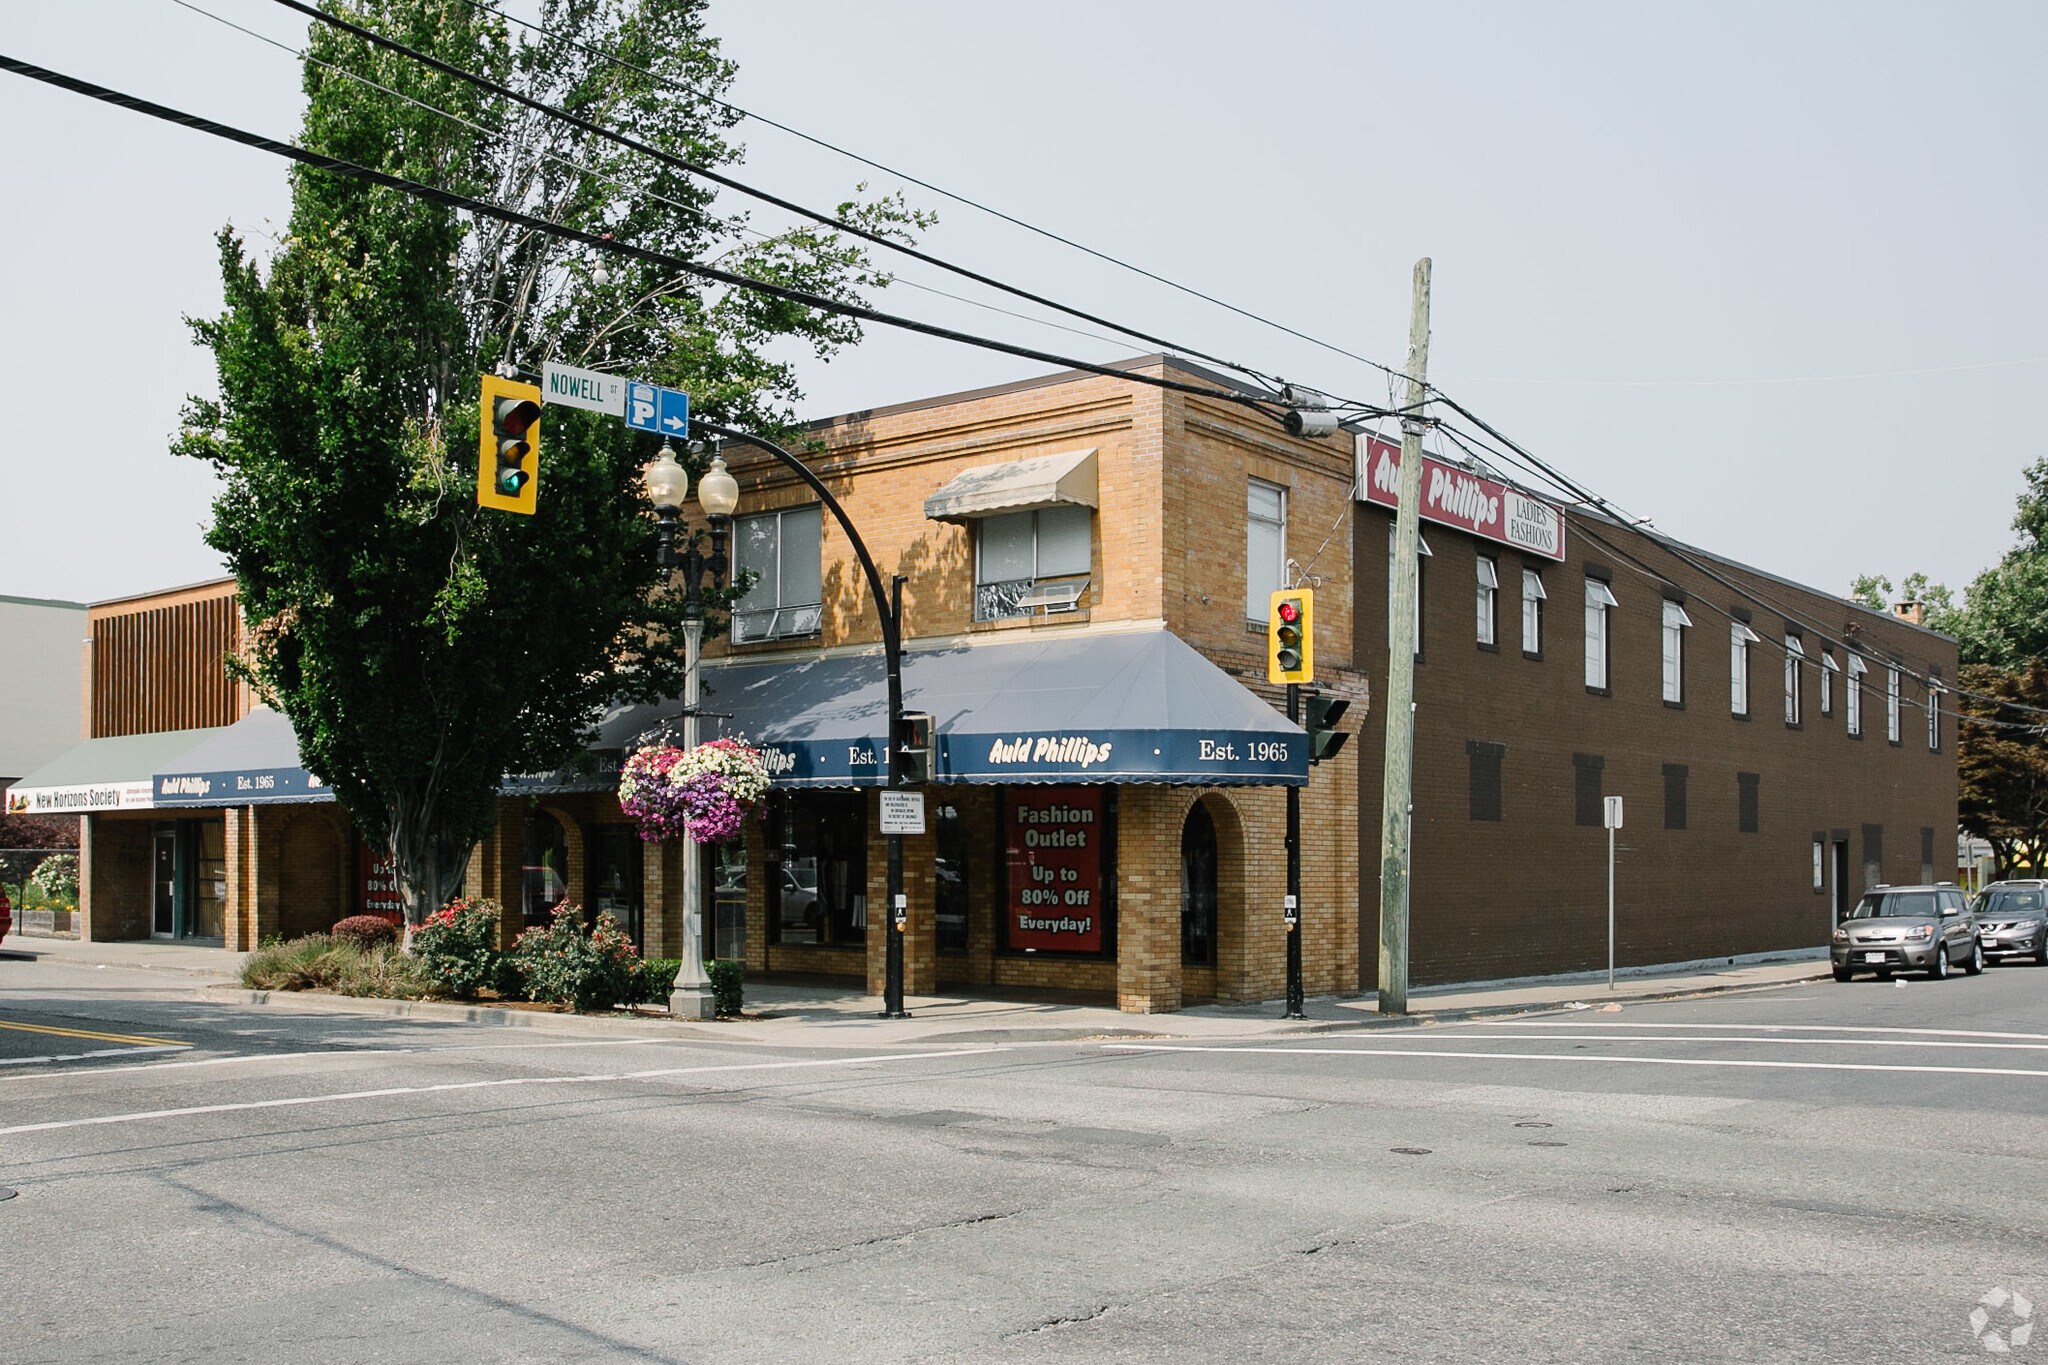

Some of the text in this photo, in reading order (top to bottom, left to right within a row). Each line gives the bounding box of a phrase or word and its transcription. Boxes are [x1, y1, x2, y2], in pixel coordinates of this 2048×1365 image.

[550, 372, 618, 403] NOWELL ST
[632, 402, 655, 426] P
[1428, 466, 1499, 531] Phillips
[1516, 498, 1548, 525] LADIES
[1510, 518, 1553, 550] FASHIONS
[760, 748, 796, 775] illips
[848, 746, 877, 765] Est.
[988, 735, 1289, 768] Auld Phillips Est. 1965
[236, 776, 253, 790] Est.
[255, 775, 275, 789] 1965
[36, 792, 52, 808] New
[53, 790, 88, 807] Horizons
[90, 788, 121, 807] Society
[1017, 806, 1094, 824] Fashion
[1025, 829, 1086, 847] Outlet
[1032, 865, 1078, 884] Up to
[1021, 889, 1090, 905] 80% Off
[1019, 915, 1091, 934] Everyday!
